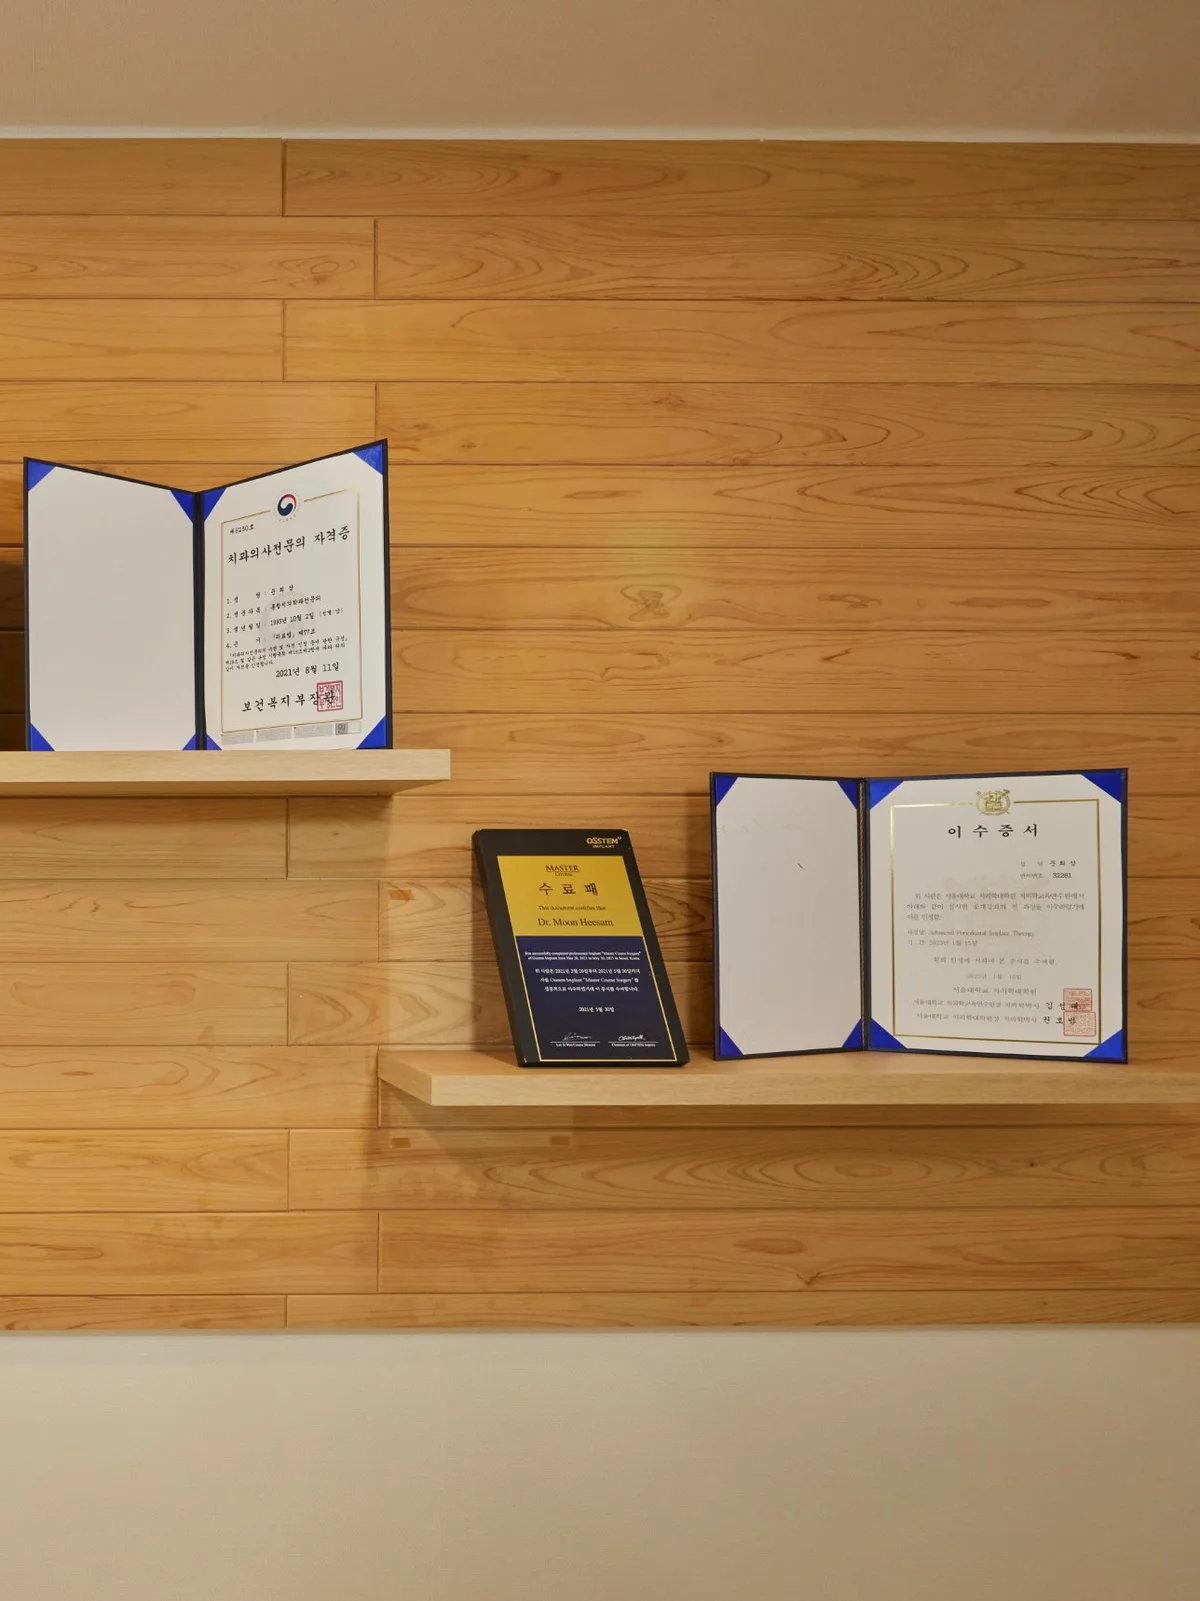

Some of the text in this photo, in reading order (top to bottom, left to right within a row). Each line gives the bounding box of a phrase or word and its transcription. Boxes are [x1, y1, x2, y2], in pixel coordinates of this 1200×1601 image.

[227, 525, 350, 565] 치과의사전문의 자격증
[276, 661, 339, 678] 2021년 8월 11일
[242, 690, 335, 712] 보건복지부장관
[586, 836, 619, 845] OSSTEM
[538, 918, 614, 926] Dr. Moon Heesam
